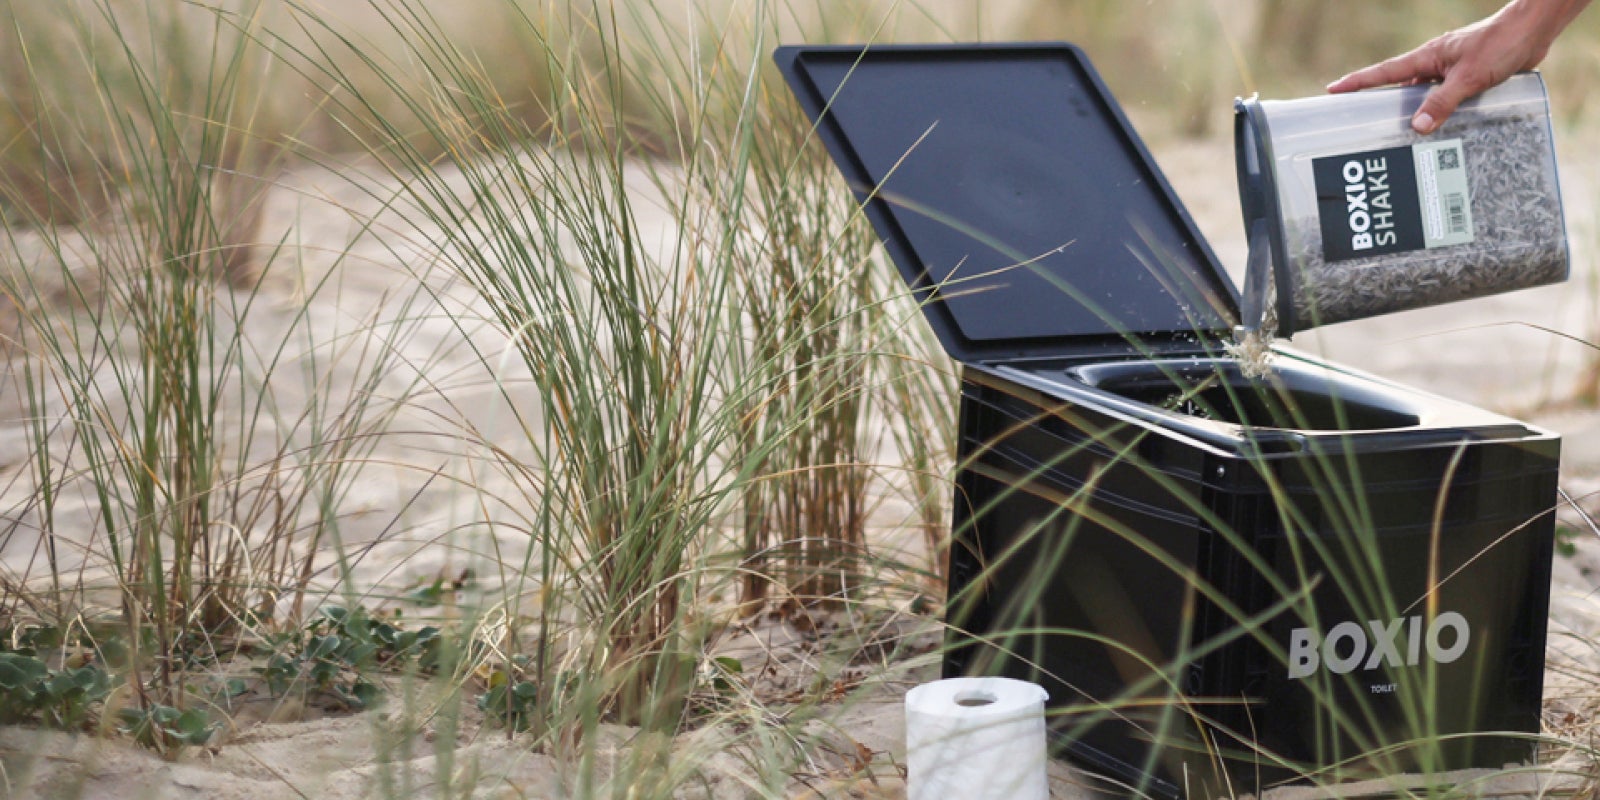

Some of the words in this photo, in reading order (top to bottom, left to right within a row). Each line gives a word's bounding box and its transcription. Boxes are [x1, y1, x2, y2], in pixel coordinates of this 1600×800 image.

[1342, 160, 1374, 250] BOXIO
[1365, 156, 1397, 246] SHAKE
[1288, 611, 1470, 680] BOXIO
[1370, 683, 1397, 694] TOILET
